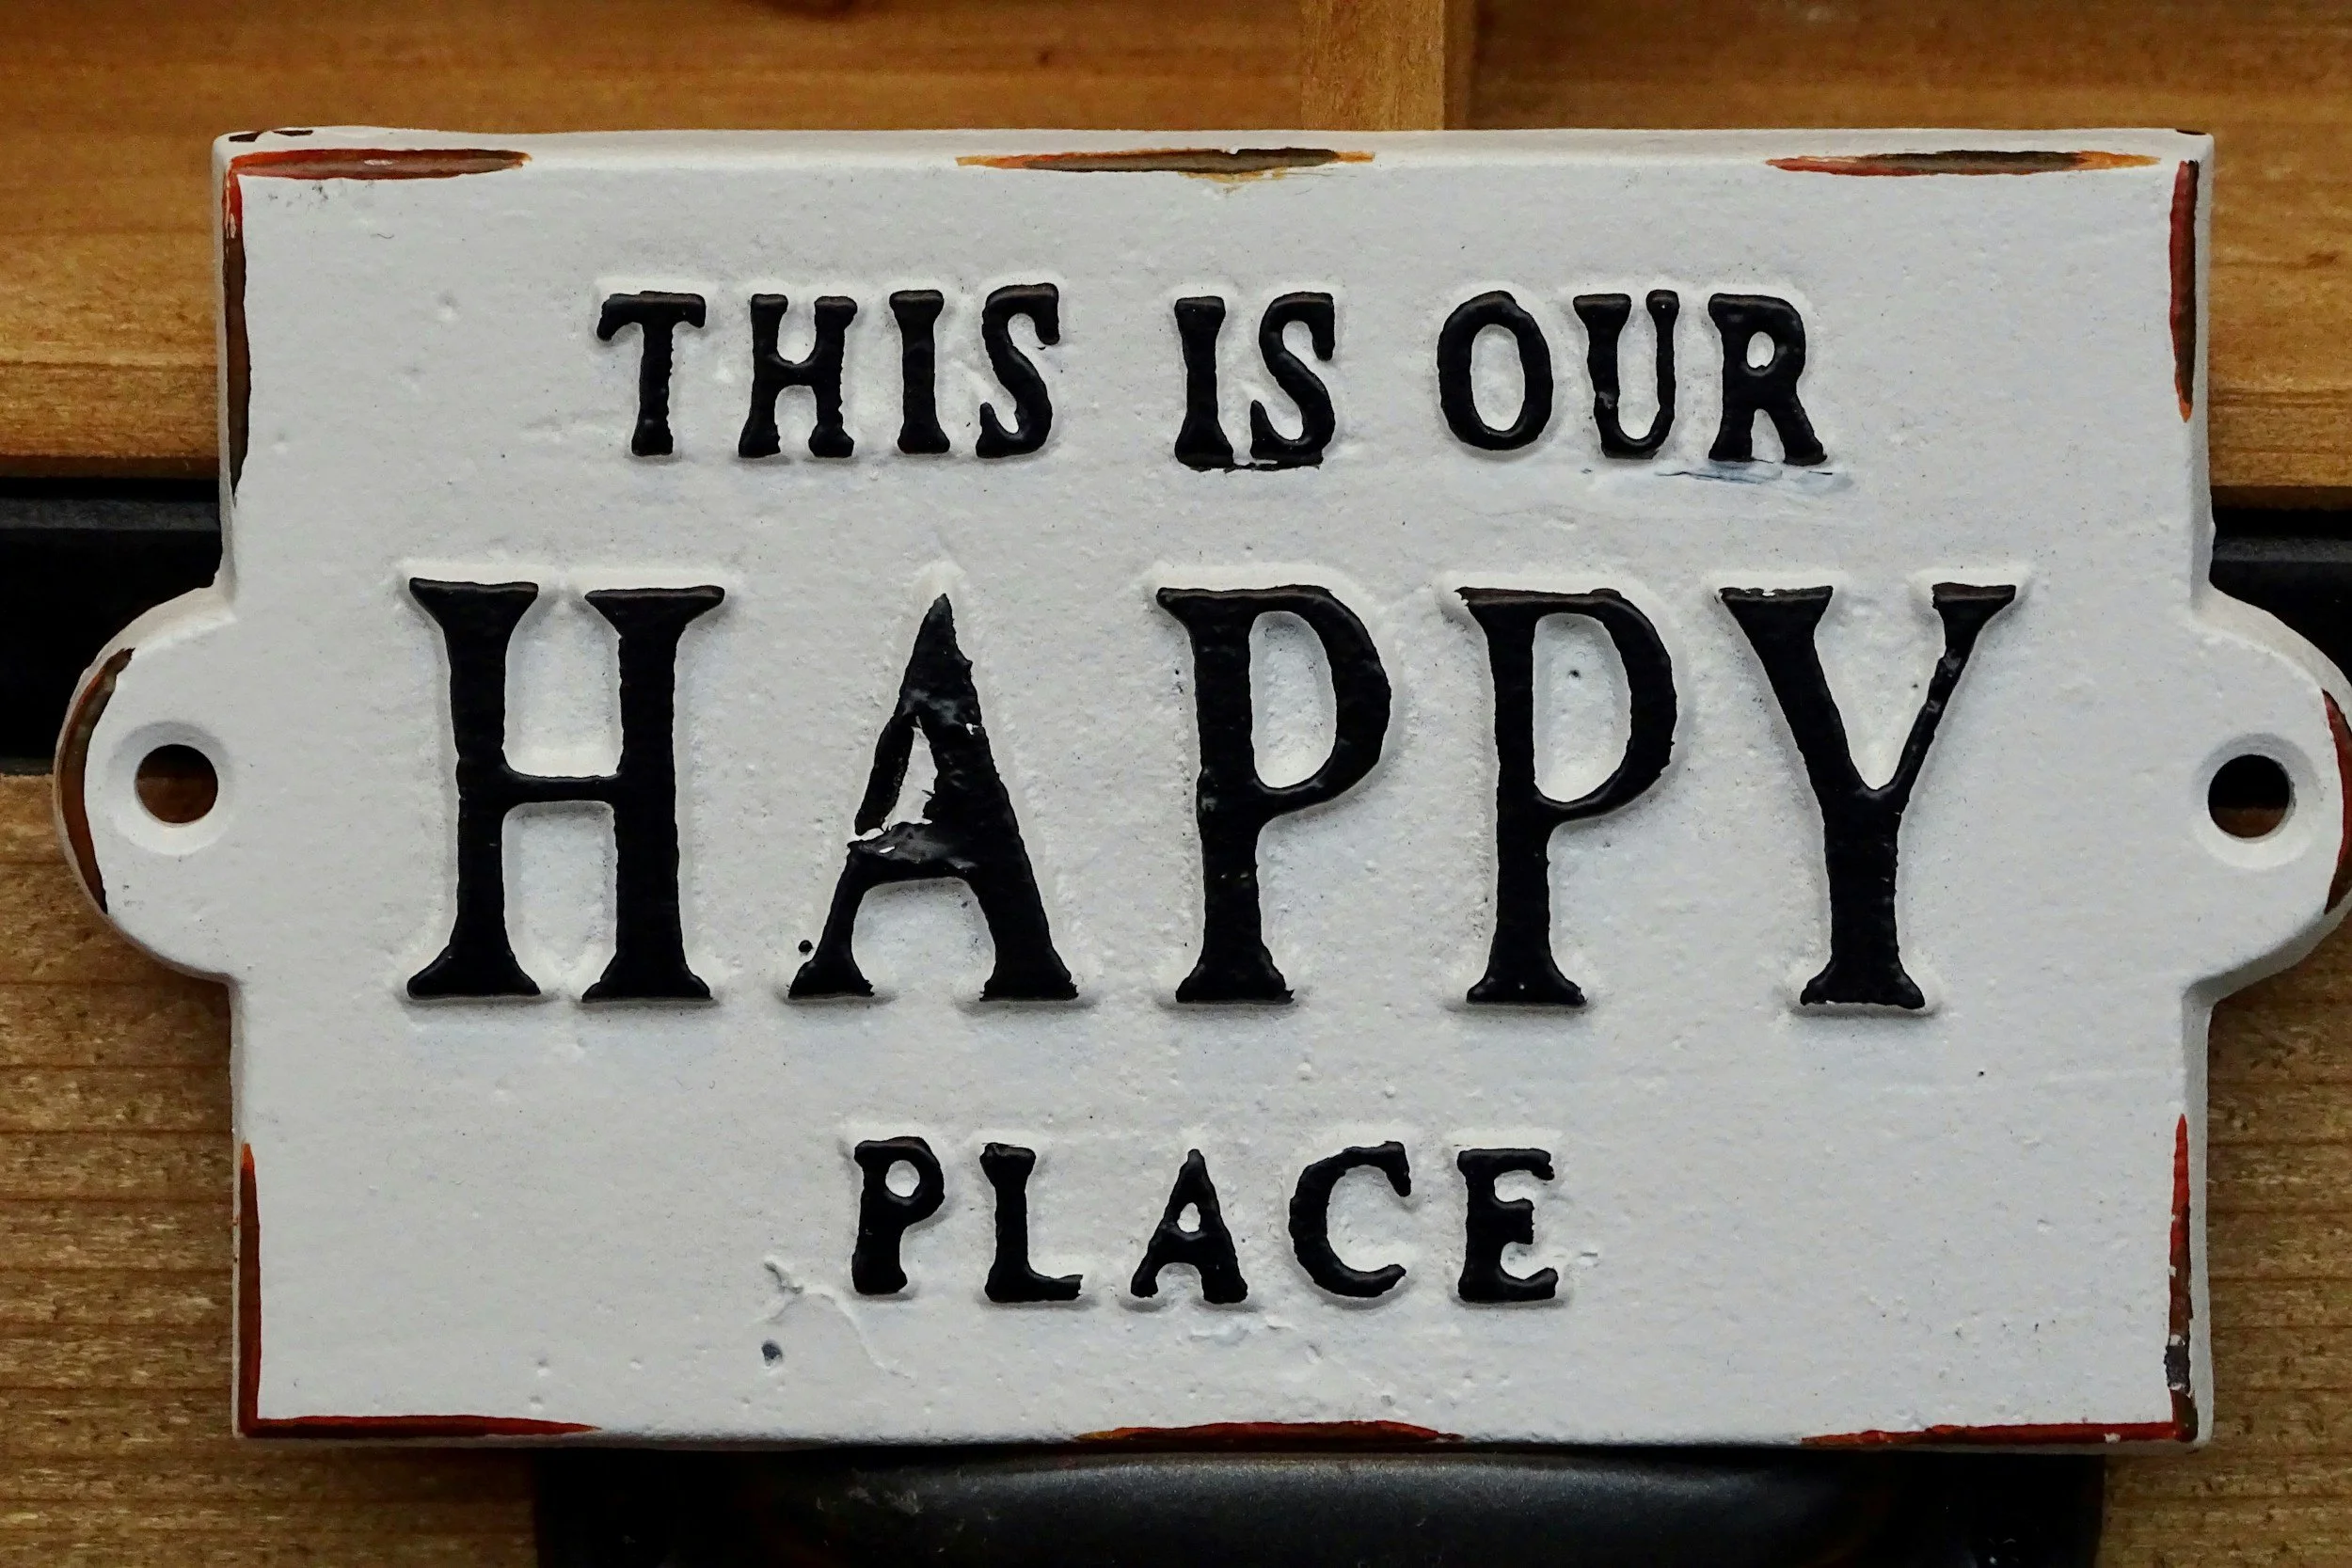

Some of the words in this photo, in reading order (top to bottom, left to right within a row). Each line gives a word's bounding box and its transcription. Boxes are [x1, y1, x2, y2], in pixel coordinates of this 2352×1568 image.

[596, 283, 1060, 458] THIS
[1174, 292, 1335, 470] IS
[1437, 291, 1827, 465] OUR
[407, 578, 2016, 1006] HAPPY
[851, 1136, 1558, 1304] PLACE
